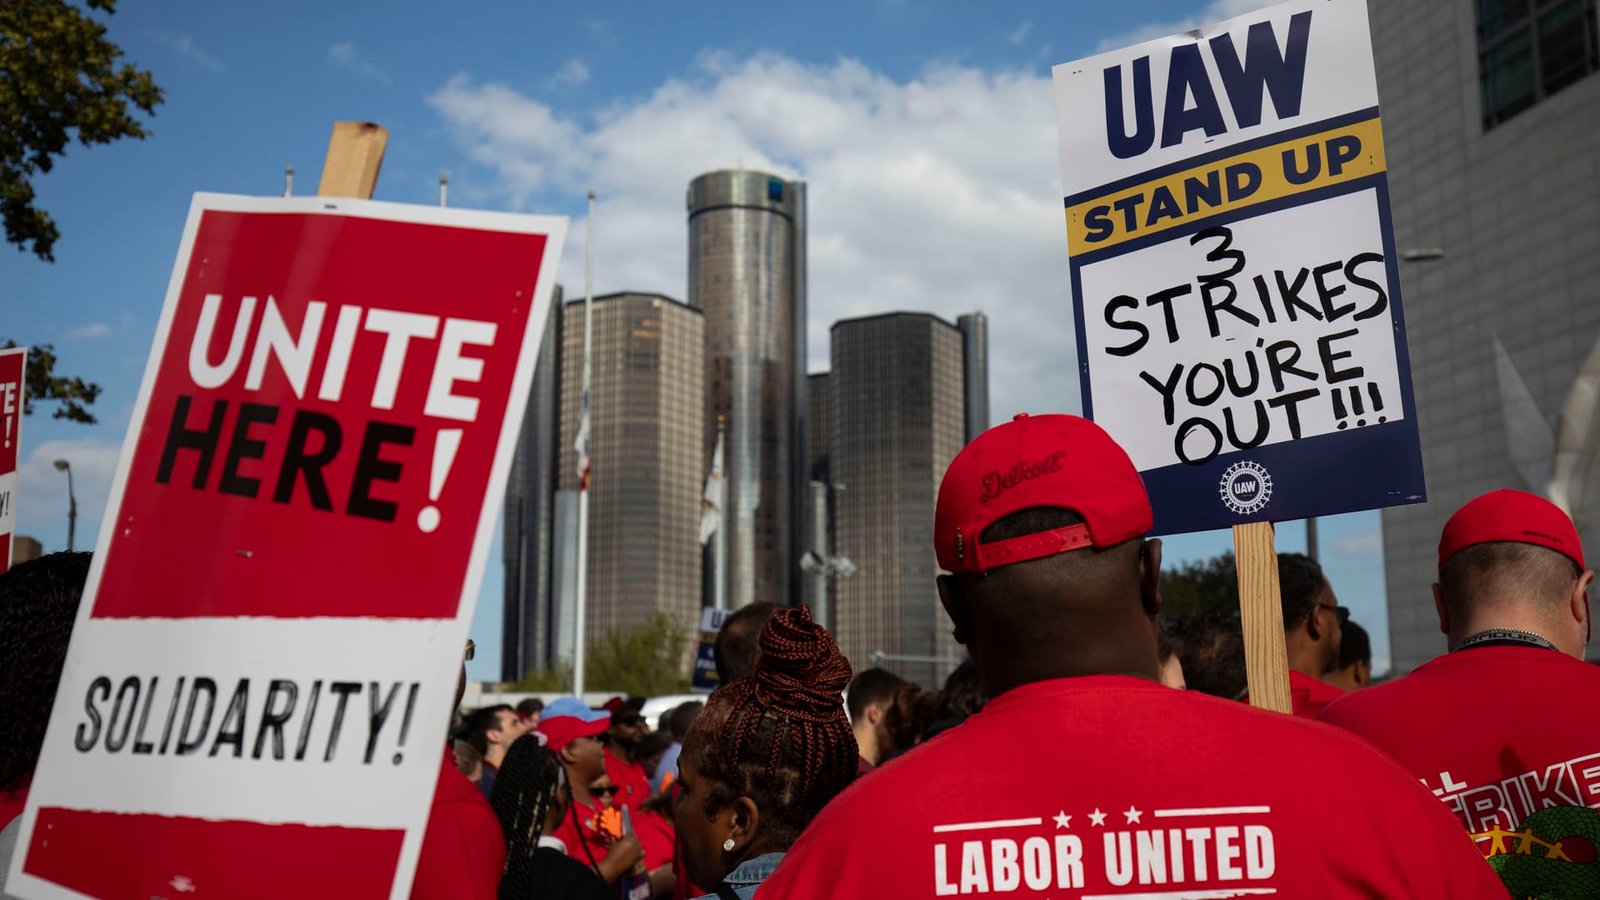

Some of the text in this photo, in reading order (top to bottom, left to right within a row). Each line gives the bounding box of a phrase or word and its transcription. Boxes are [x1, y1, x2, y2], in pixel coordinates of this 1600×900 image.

[1103, 10, 1313, 159] UAW
[1083, 135, 1362, 242] STAND UP
[1190, 227, 1246, 283] 3
[1103, 252, 1387, 356] STRIKES
[188, 294, 498, 422] UNITE
[1139, 327, 1365, 426] YOU'RE
[980, 451, 1067, 504] Detroit
[1234, 480, 1256, 494] UAW
[75, 675, 421, 766] SOLIDARITY!
[934, 825, 1276, 896] LABOR UNITED
